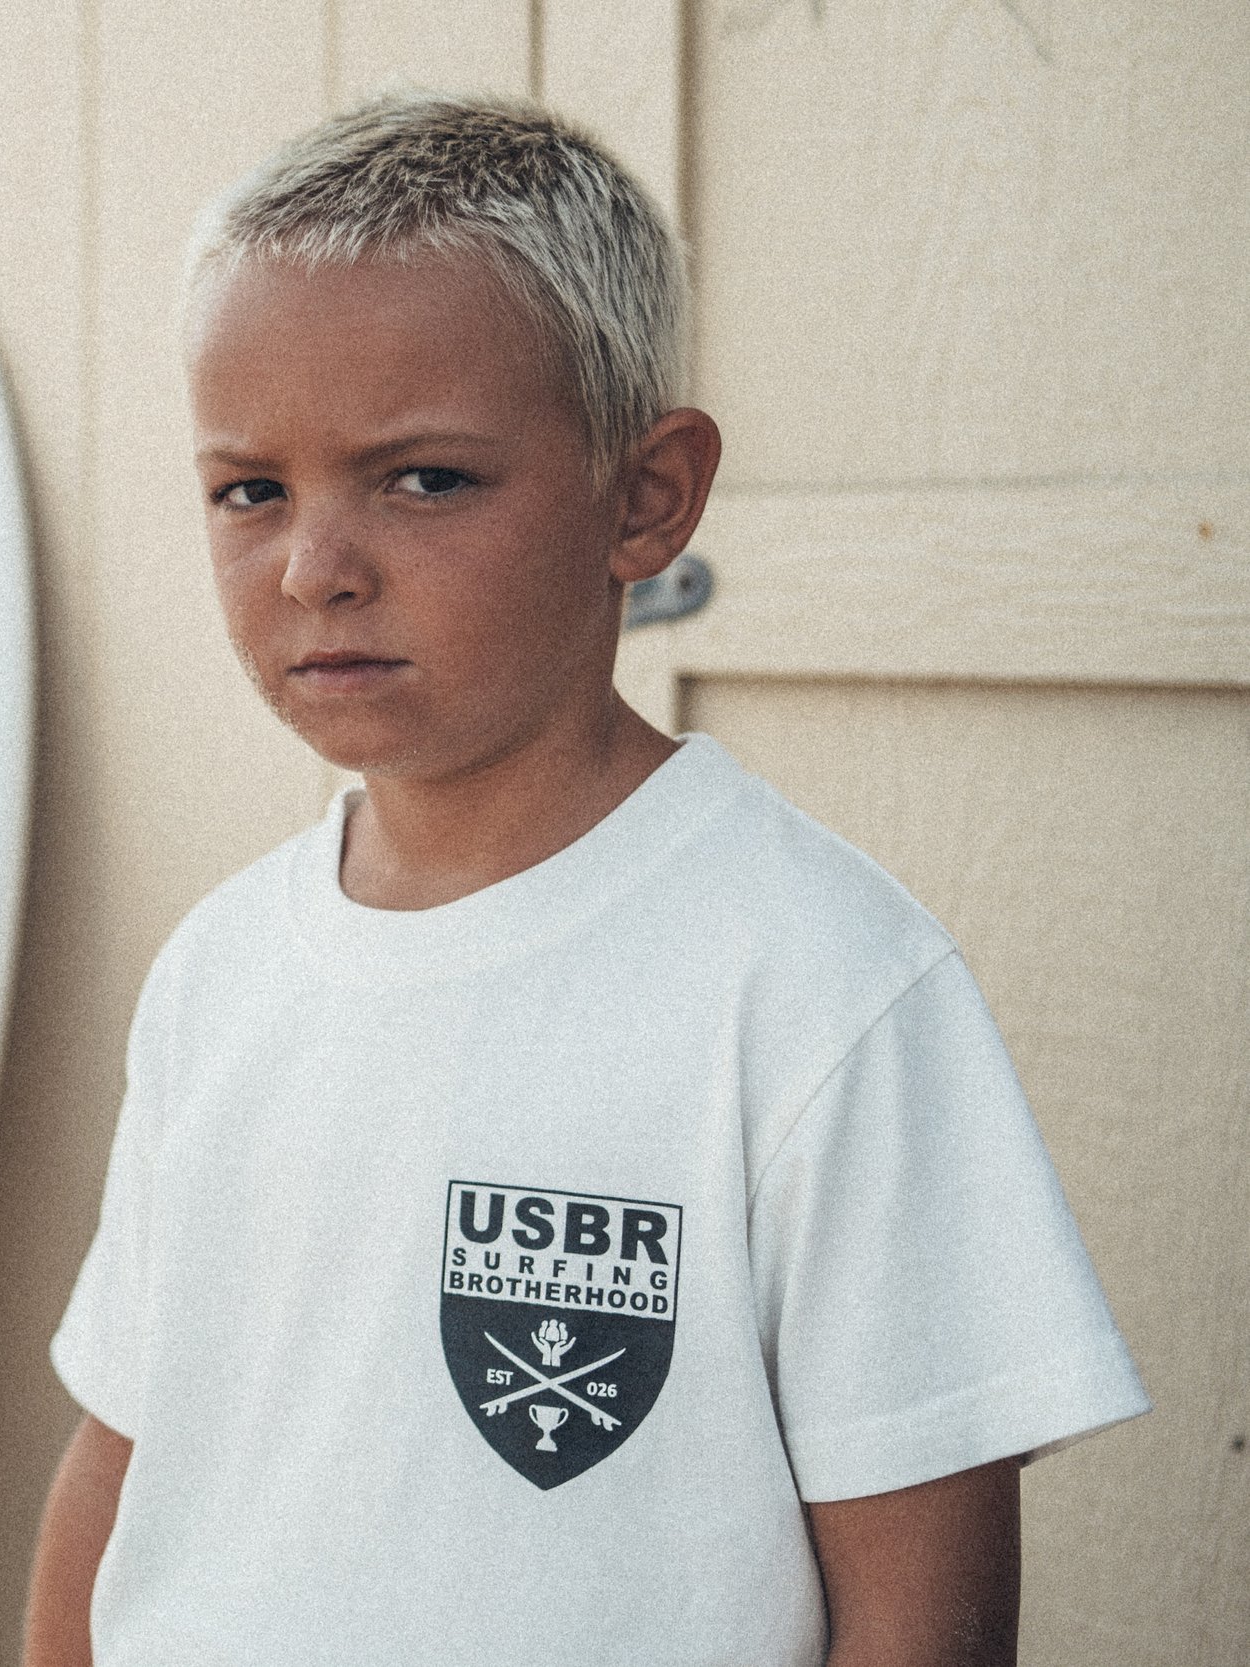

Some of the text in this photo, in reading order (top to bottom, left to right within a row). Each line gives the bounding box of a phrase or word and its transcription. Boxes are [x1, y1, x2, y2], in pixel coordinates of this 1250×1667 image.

[459, 1190, 669, 1266] USBR
[452, 1247, 668, 1291] SURFING
[449, 1270, 669, 1314] BROTHERHOOD
[486, 1368, 514, 1386] EST
[586, 1381, 618, 1398] 026
